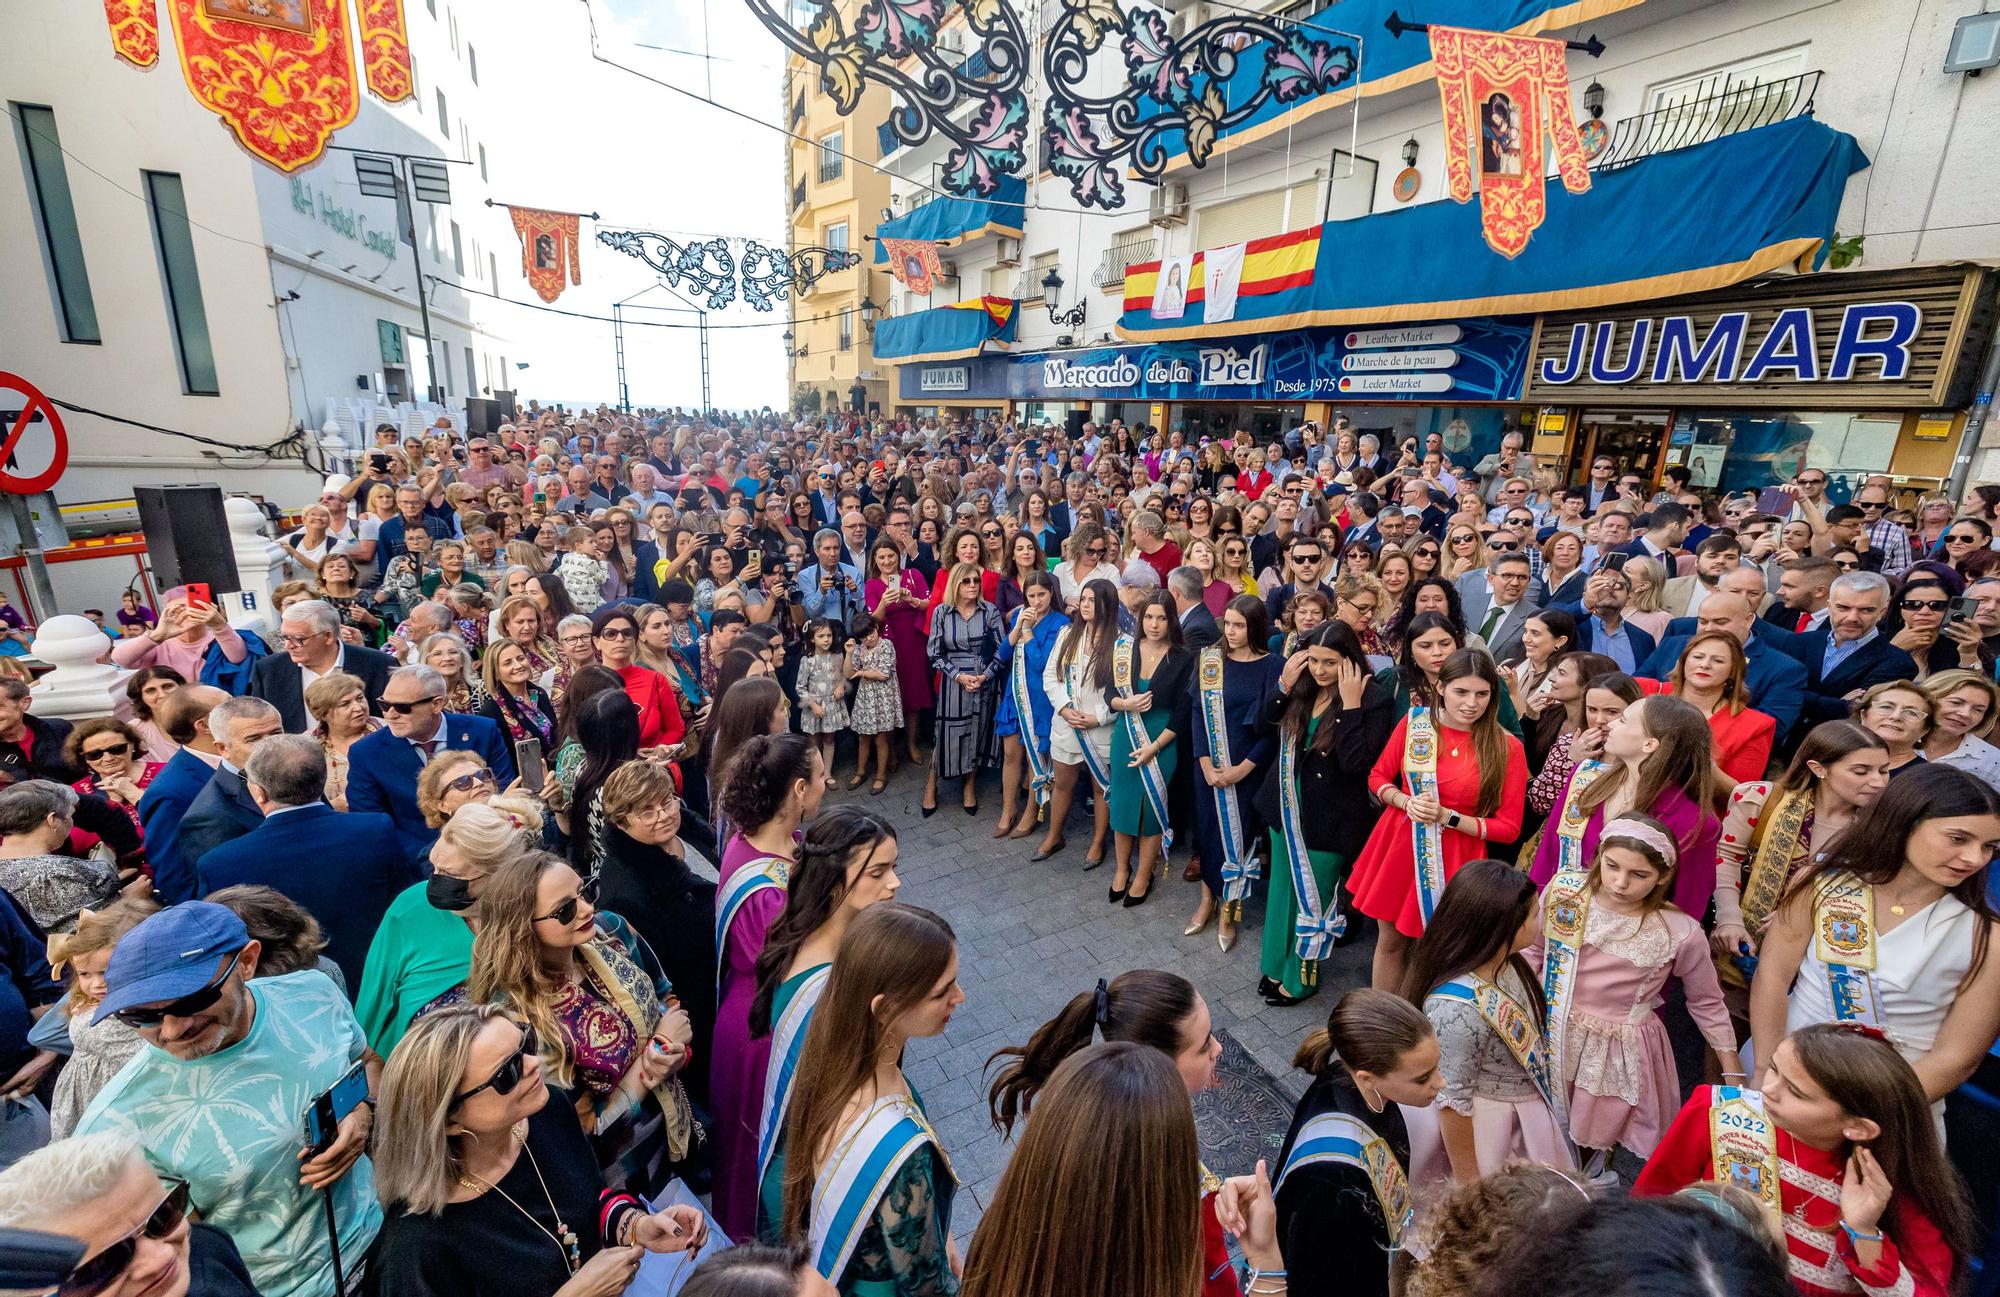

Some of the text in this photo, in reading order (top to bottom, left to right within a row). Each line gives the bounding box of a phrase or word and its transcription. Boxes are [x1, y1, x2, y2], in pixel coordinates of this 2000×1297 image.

[1365, 331, 1434, 345] Leather Market
[1540, 301, 1923, 384] JUMAR
[1045, 346, 1262, 386] Mercado de la Piel
[1390, 355, 1401, 366] de
[1403, 355, 1412, 365] la
[1413, 357, 1436, 367] peau
[923, 370, 963, 384] JUMAR
[1362, 378, 1422, 389] Leder Market
[1275, 378, 1336, 392] Desde 1975
[1825, 885, 1863, 897] 2022
[1720, 1111, 1766, 1134] 2022
